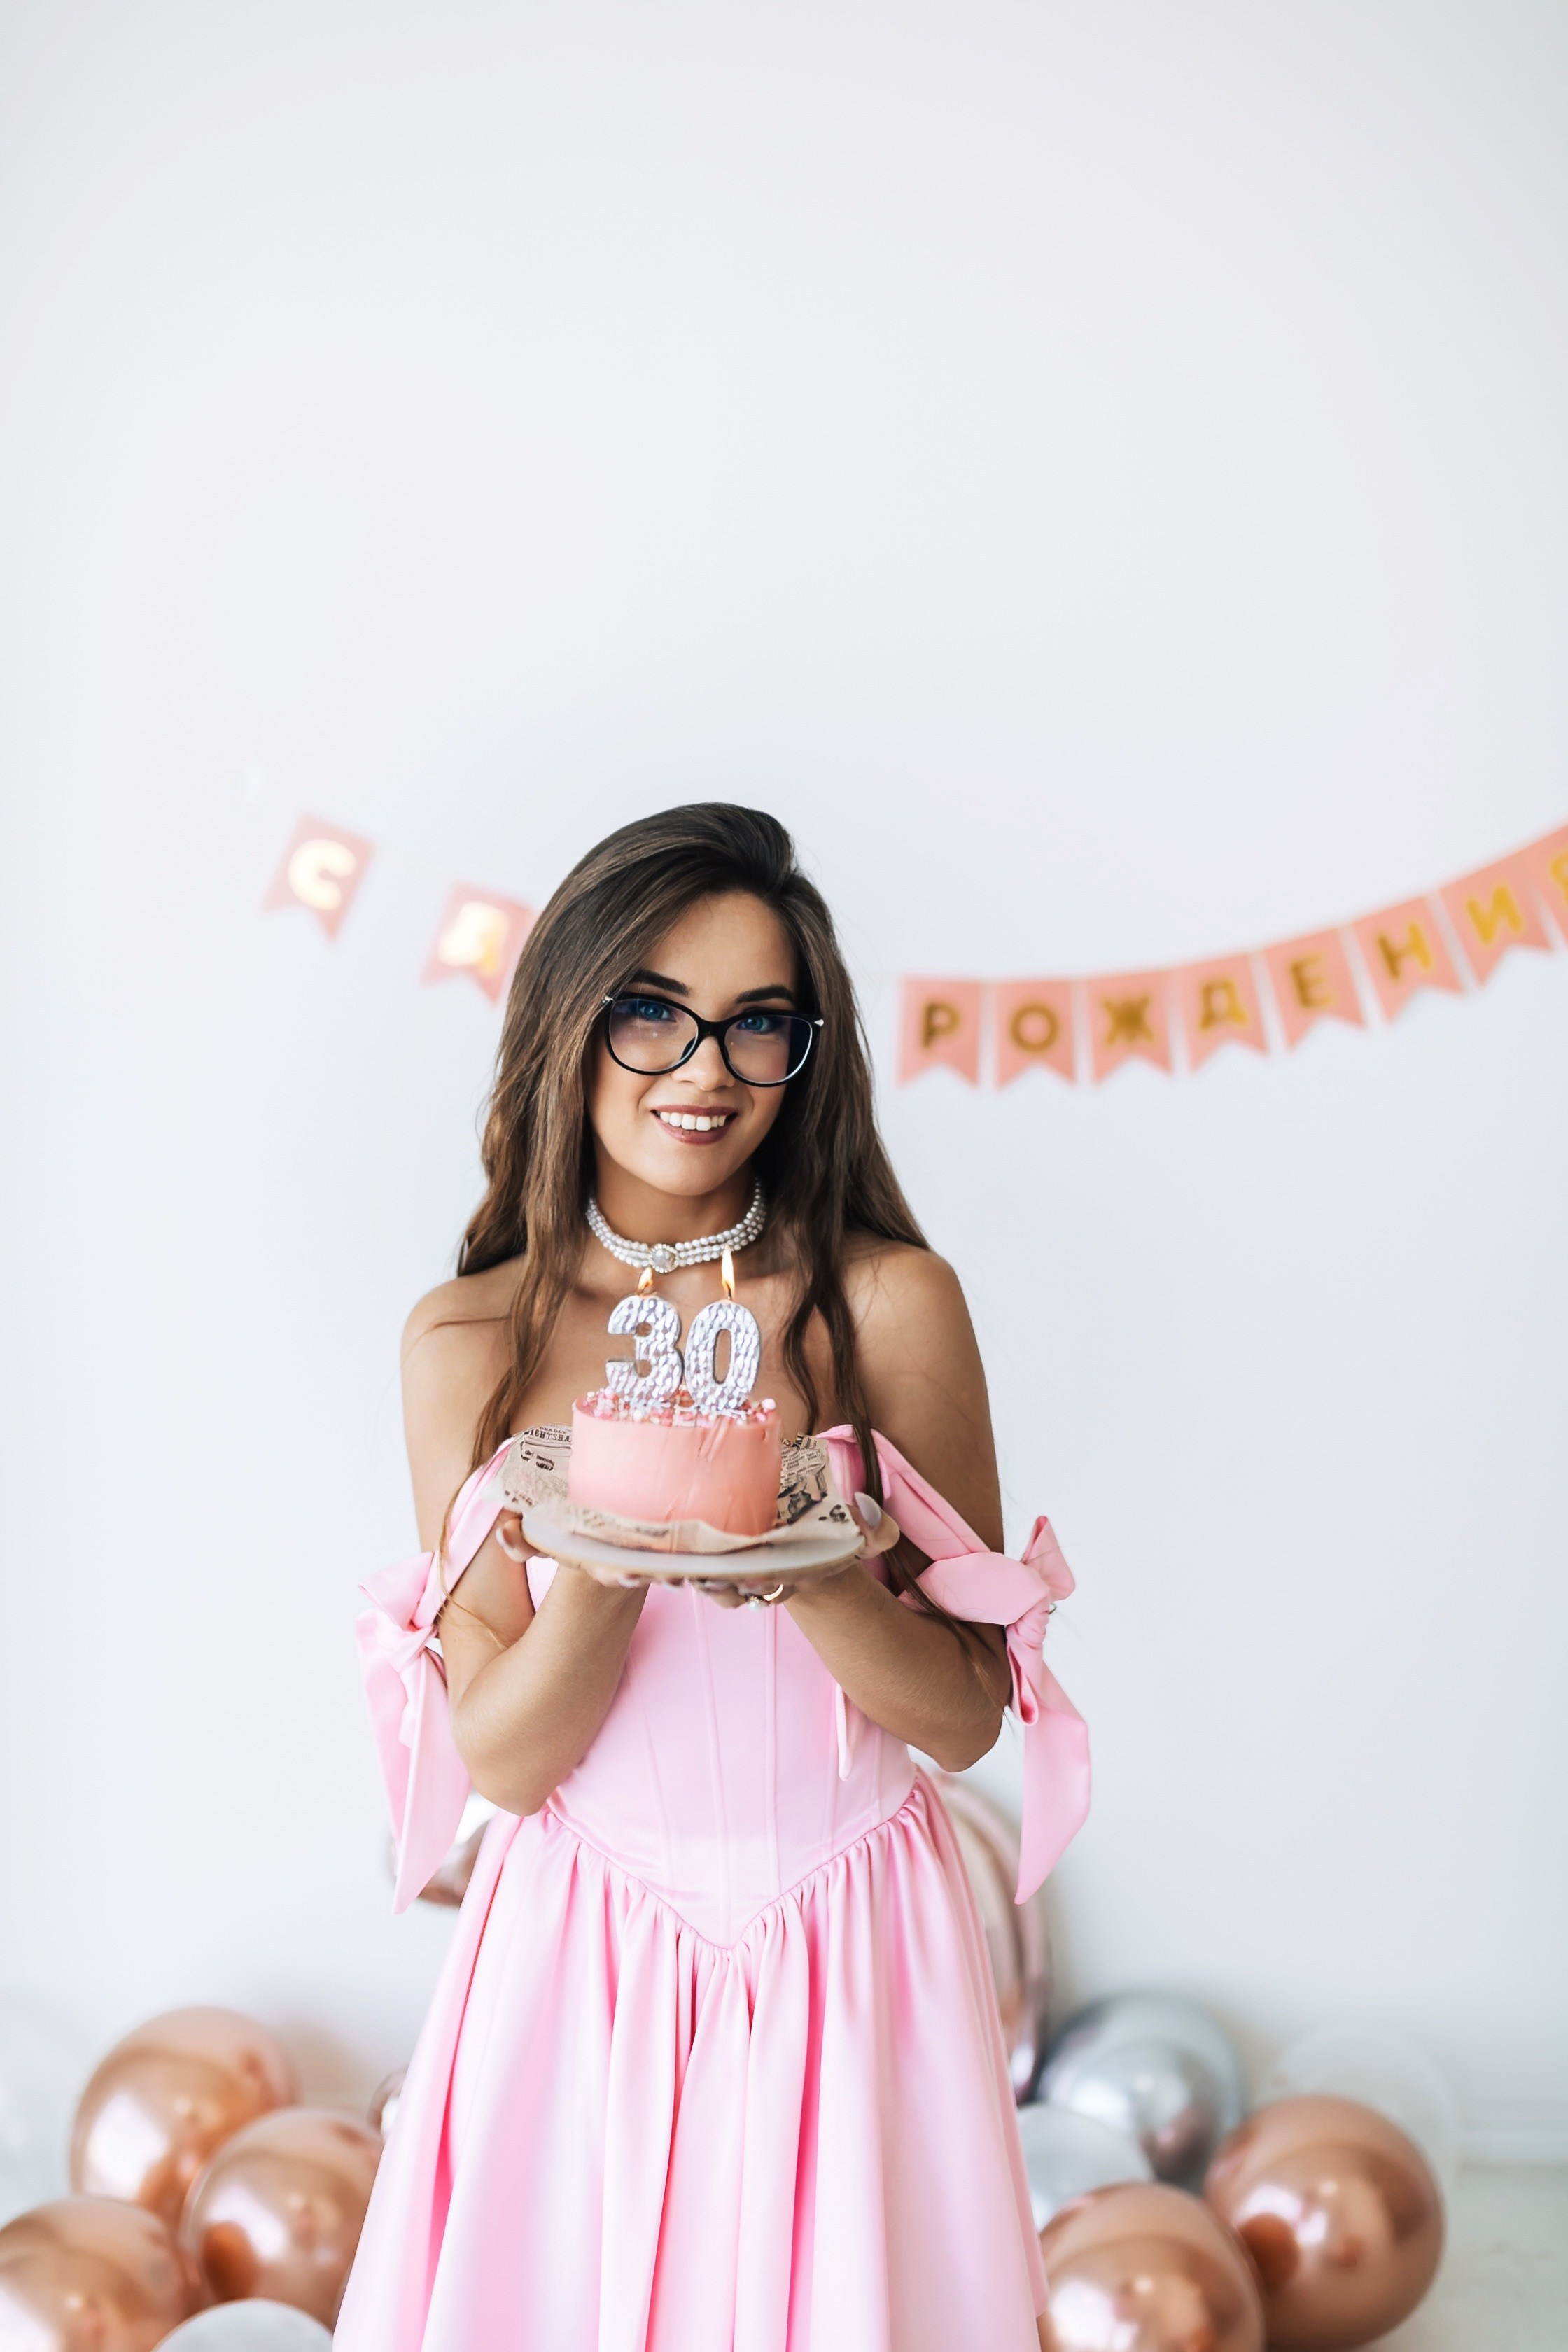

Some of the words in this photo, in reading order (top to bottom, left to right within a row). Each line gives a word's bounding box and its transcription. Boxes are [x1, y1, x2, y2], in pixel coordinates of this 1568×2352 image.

[287, 838, 358, 911] С
[606, 1295, 761, 1409] 30
[524, 1429, 570, 1442] IGHTSHA
